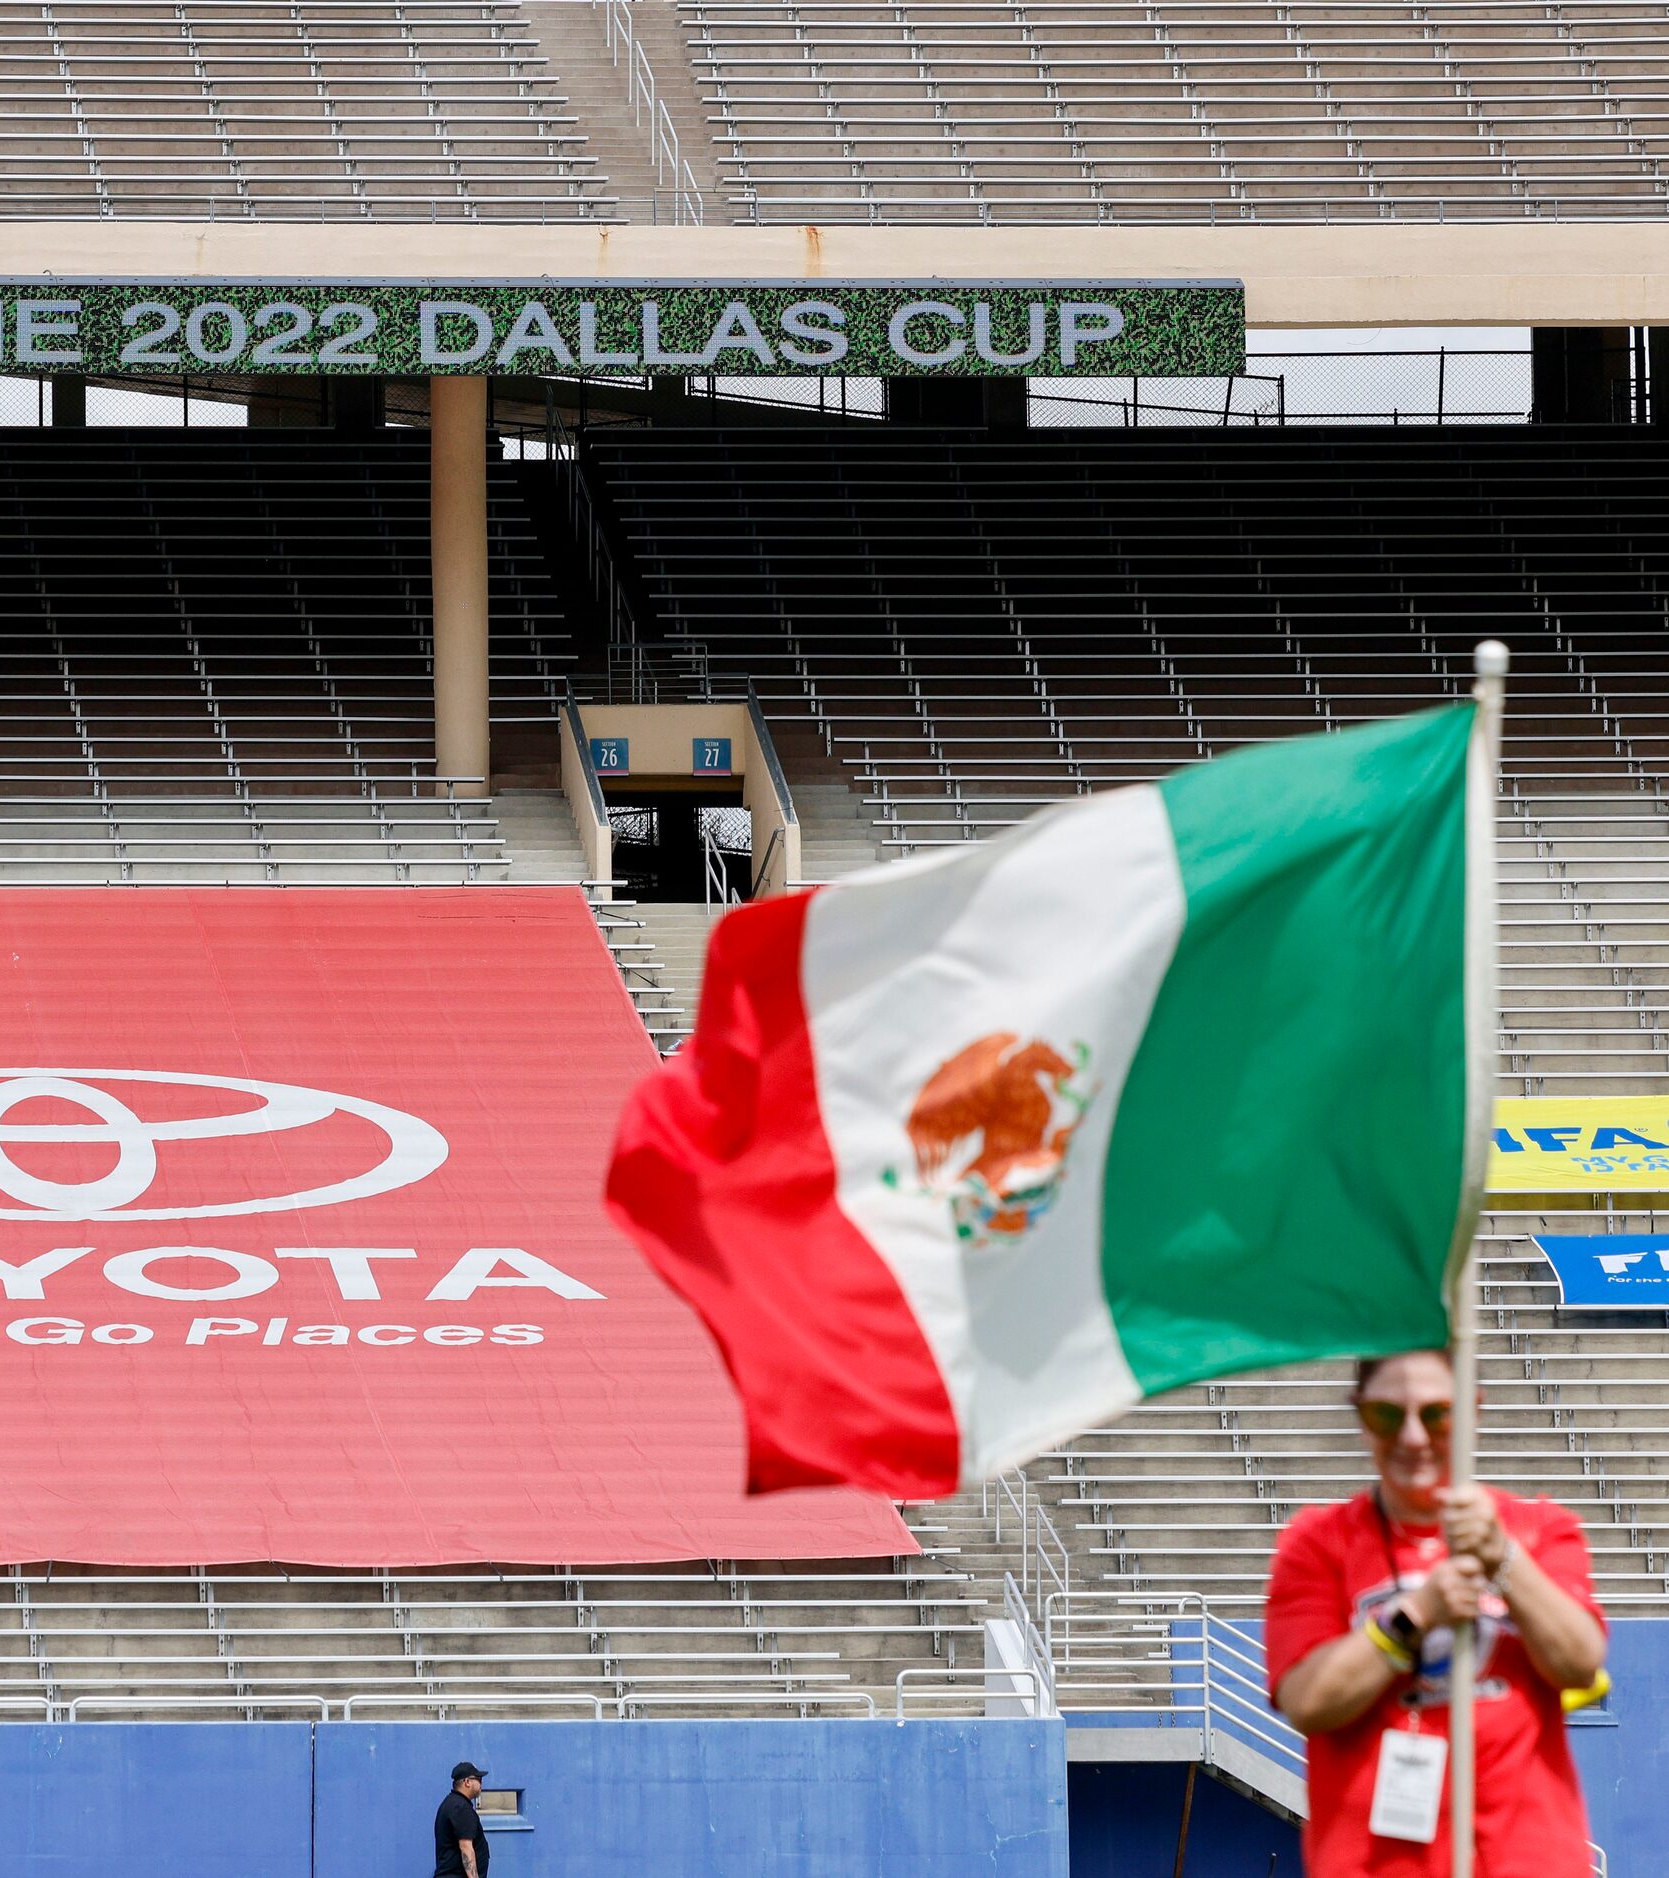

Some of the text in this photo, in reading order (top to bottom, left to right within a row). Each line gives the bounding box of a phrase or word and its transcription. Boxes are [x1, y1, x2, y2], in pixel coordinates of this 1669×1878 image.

[121, 301, 378, 365] 2022
[419, 300, 849, 366] DALLAS
[887, 301, 1125, 367] CUP
[601, 748, 618, 767] 26
[705, 748, 720, 767] 27
[5, 1316, 154, 1346] Go
[185, 1317, 545, 1346] Places
